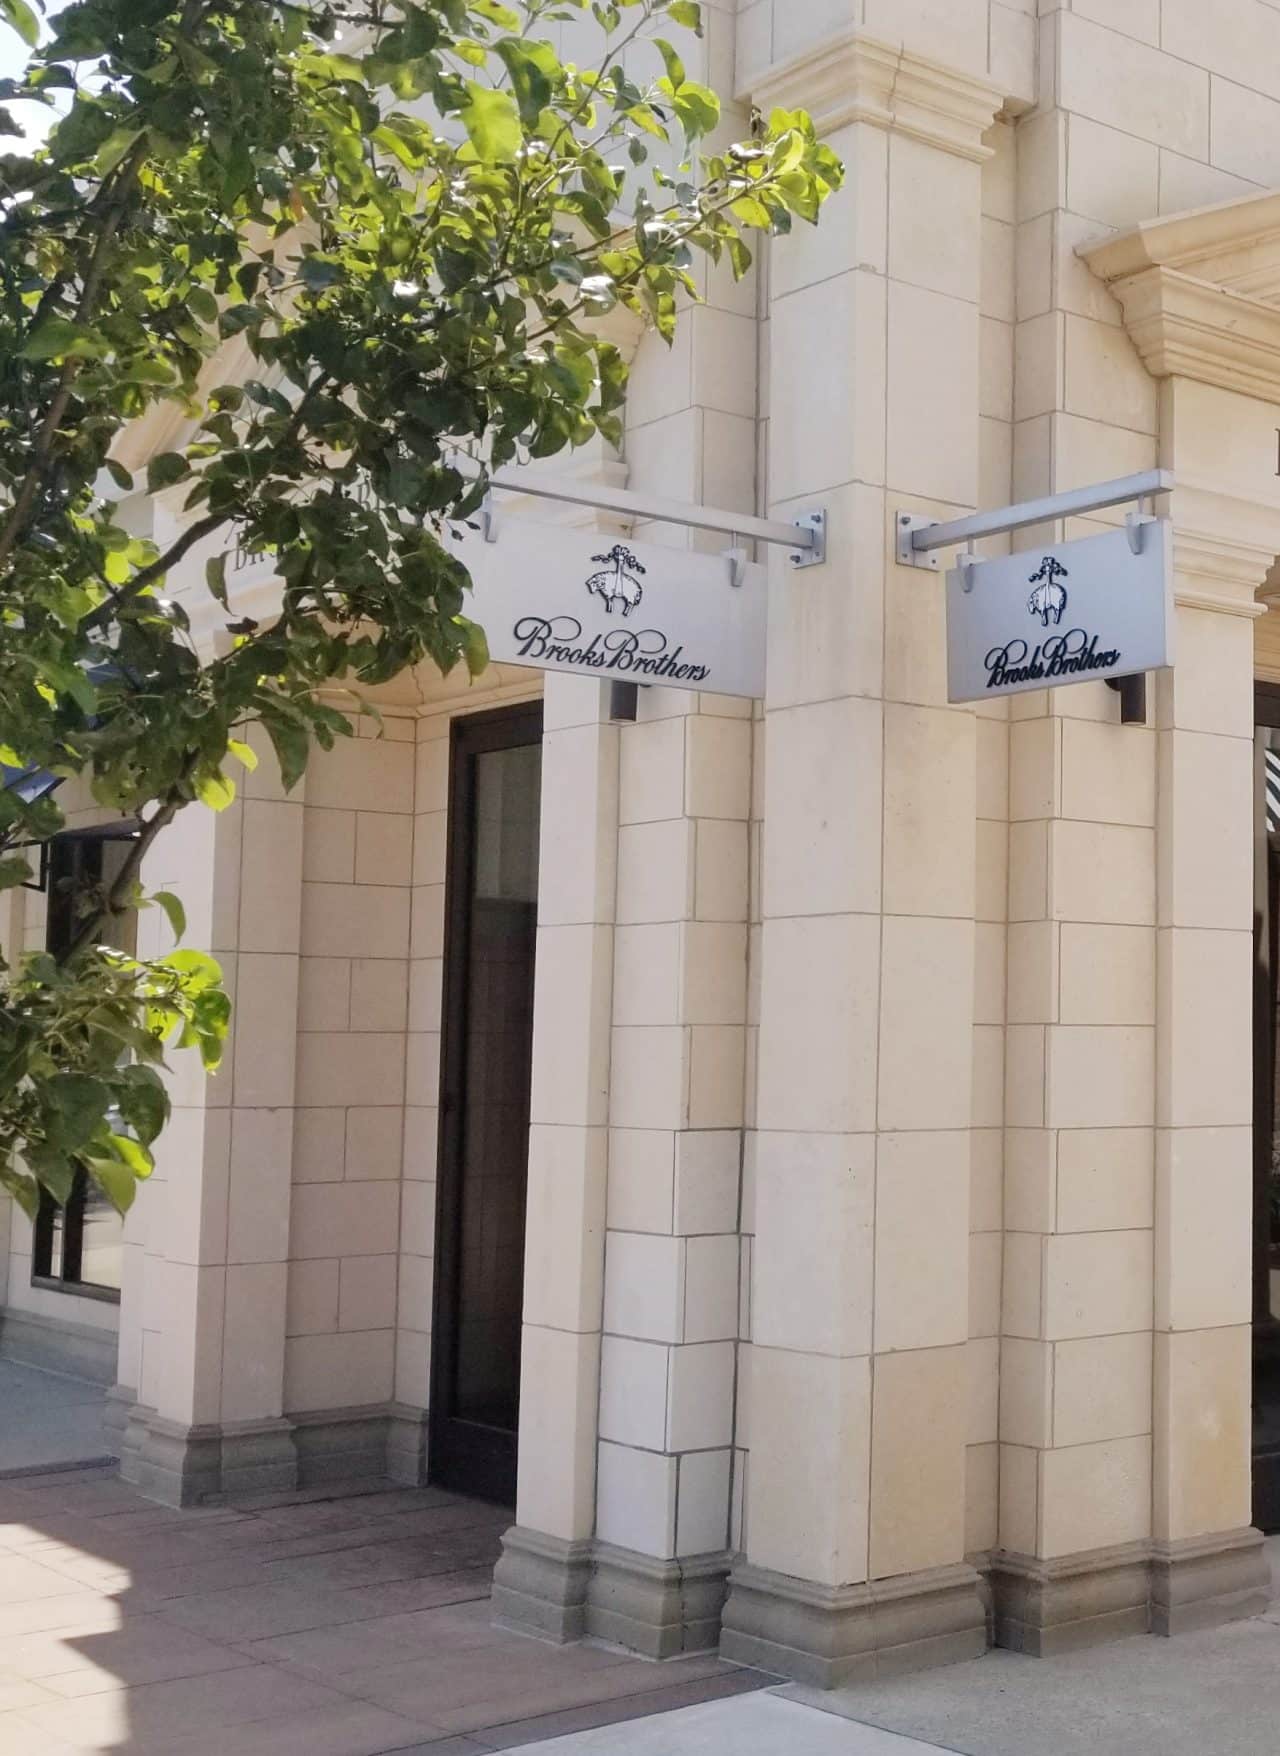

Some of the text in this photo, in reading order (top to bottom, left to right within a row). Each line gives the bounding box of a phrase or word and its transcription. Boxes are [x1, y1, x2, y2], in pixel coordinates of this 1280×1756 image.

[513, 616, 711, 681] Brooks Brothers
[984, 628, 1121, 688] Brooks Brothers
